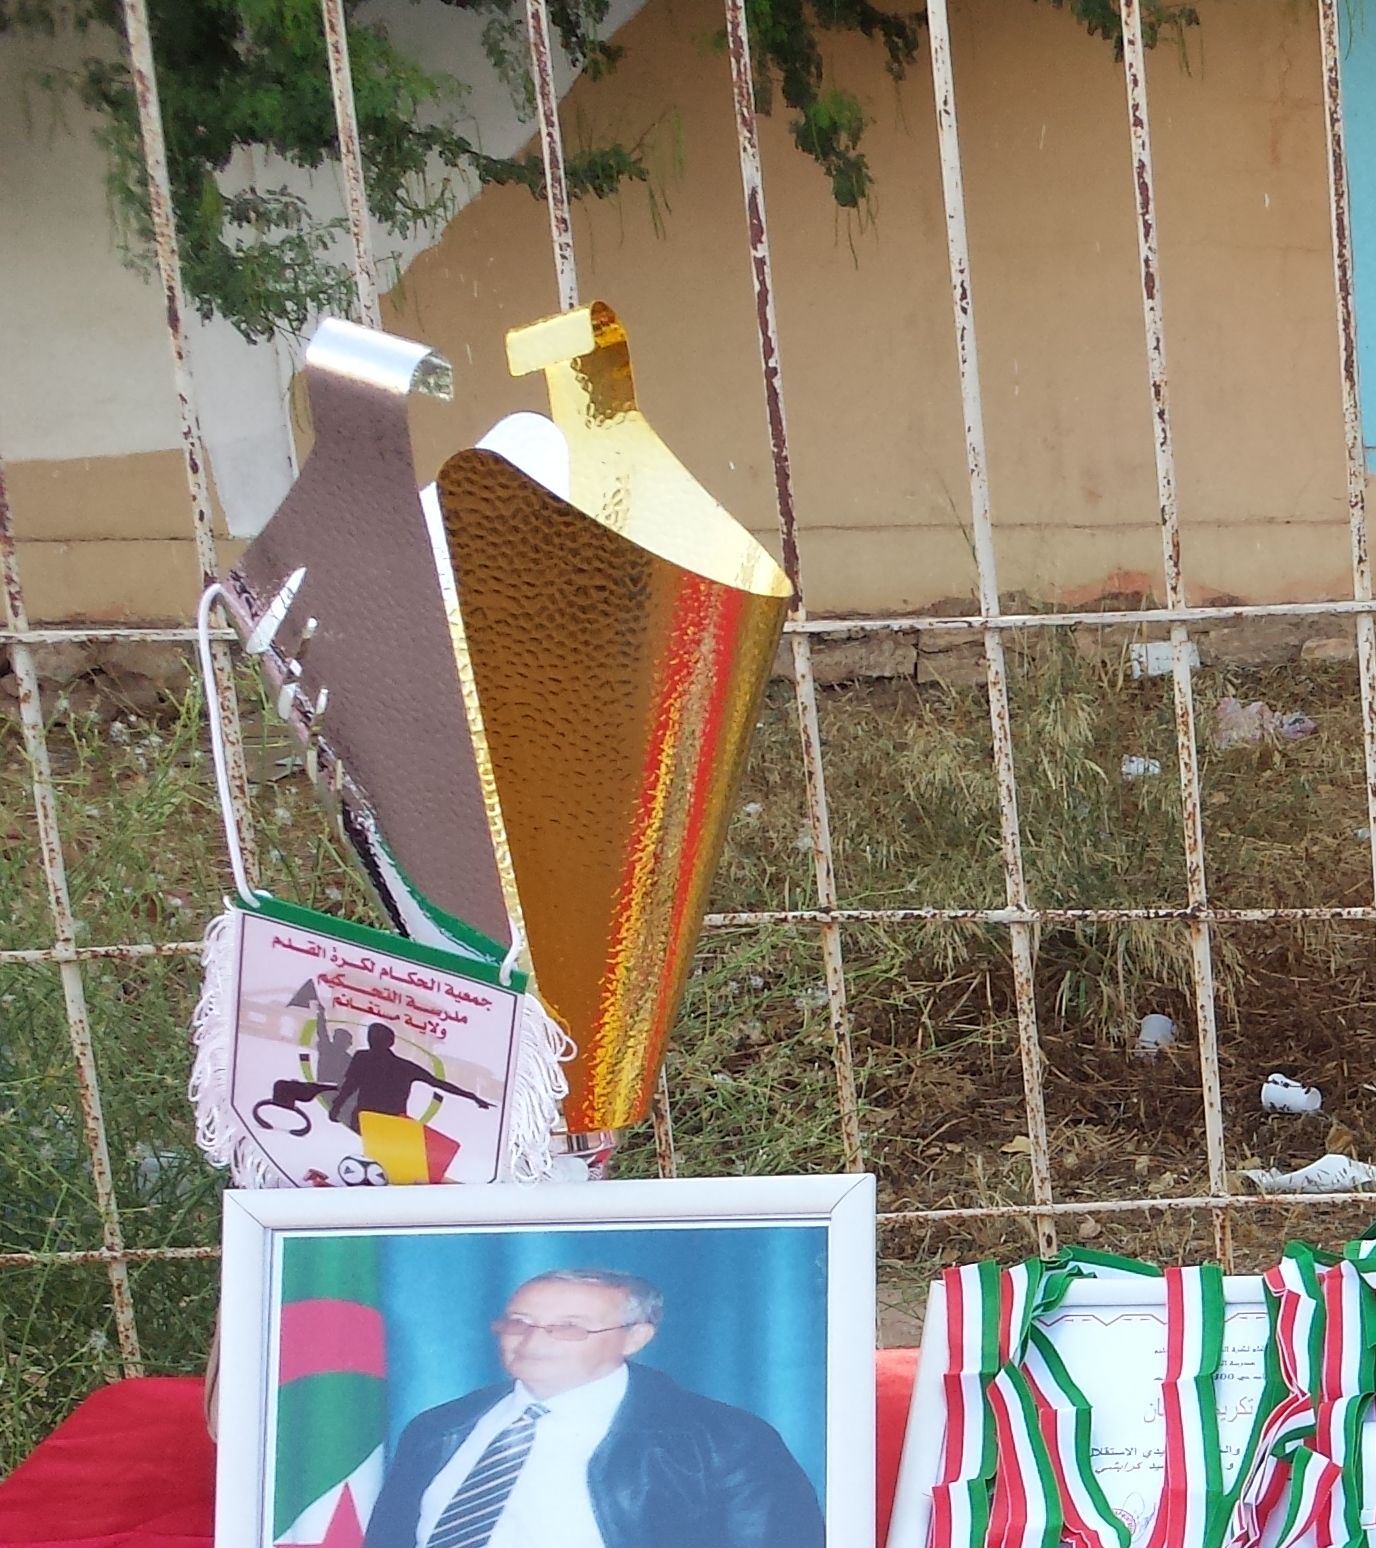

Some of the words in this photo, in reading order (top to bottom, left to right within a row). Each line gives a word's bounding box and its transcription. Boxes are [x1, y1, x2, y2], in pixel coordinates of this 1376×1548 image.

[271, 934, 326, 959] القدم
[317, 973, 402, 1006] التحكيم
[379, 966, 441, 994] الحكام
[332, 994, 401, 1021] مستغانم
[405, 994, 469, 1025] مدرسة
[444, 982, 493, 1012] جمعية
[405, 1013, 447, 1040] ولاية
